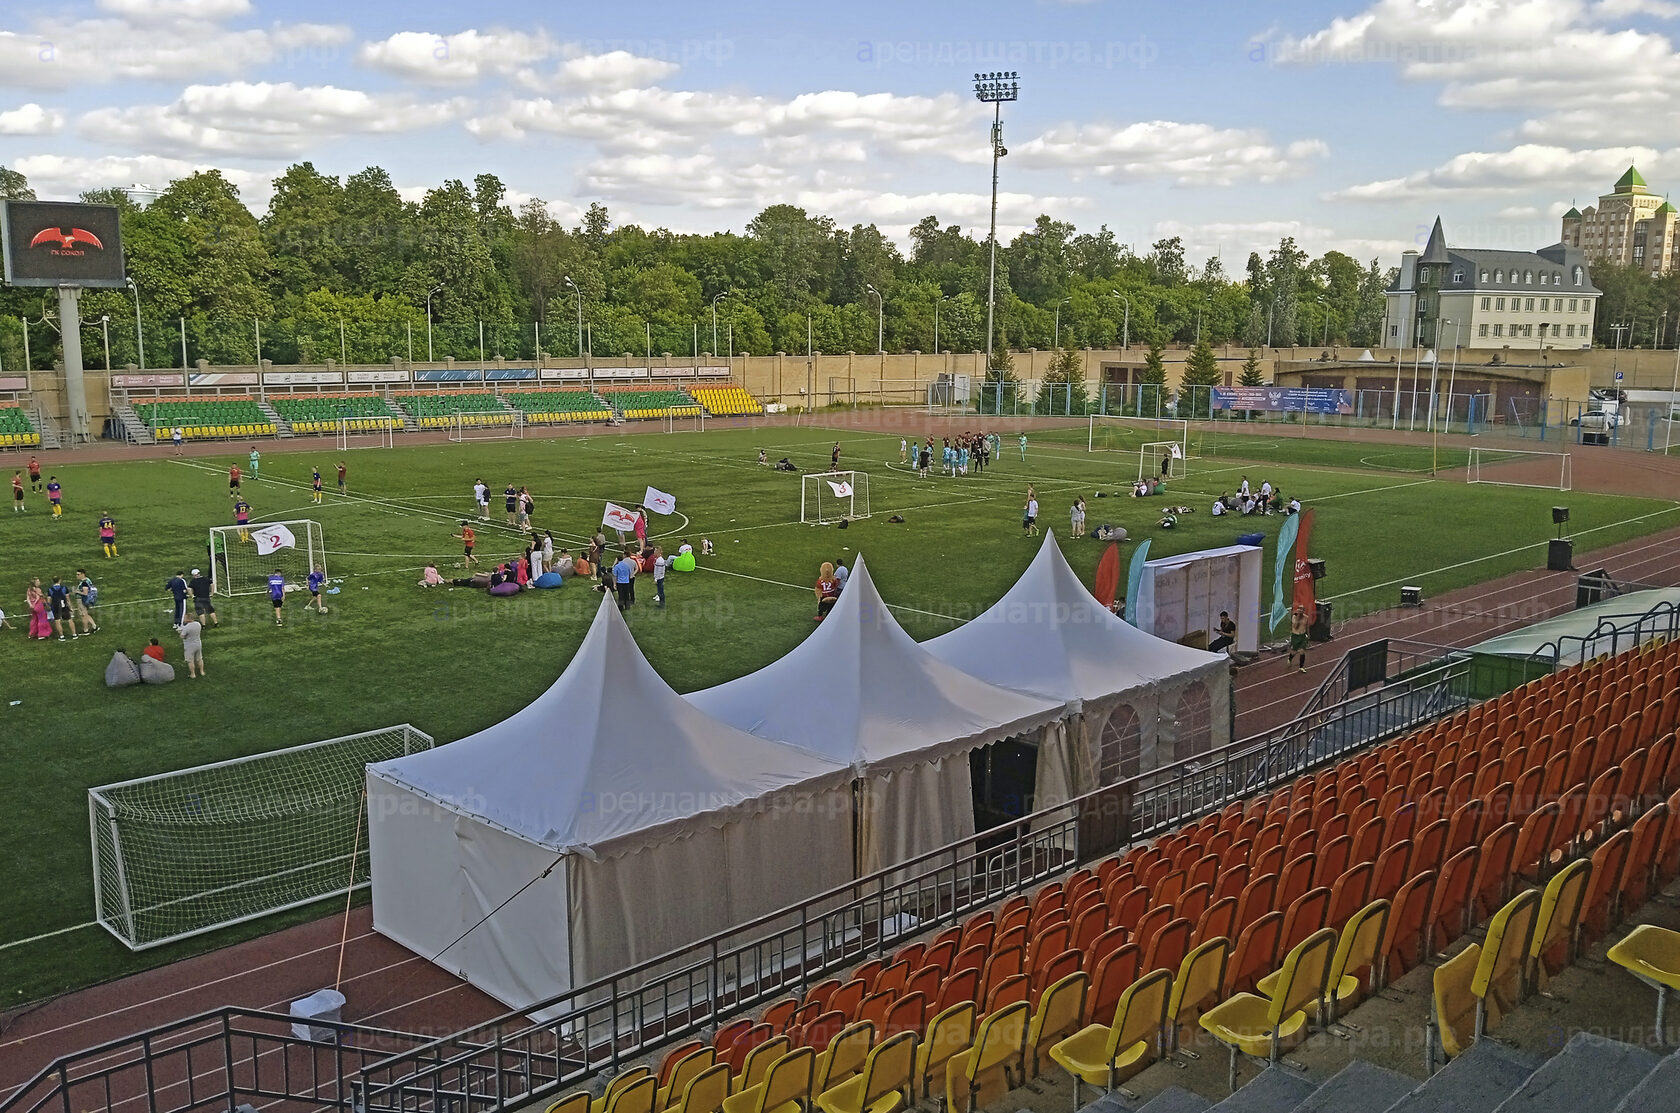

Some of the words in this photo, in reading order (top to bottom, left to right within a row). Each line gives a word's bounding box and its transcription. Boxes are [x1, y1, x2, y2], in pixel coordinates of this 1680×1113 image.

[839, 484, 847, 494] 3
[270, 535, 282, 549] 2
[821, 581, 832, 592] 12
